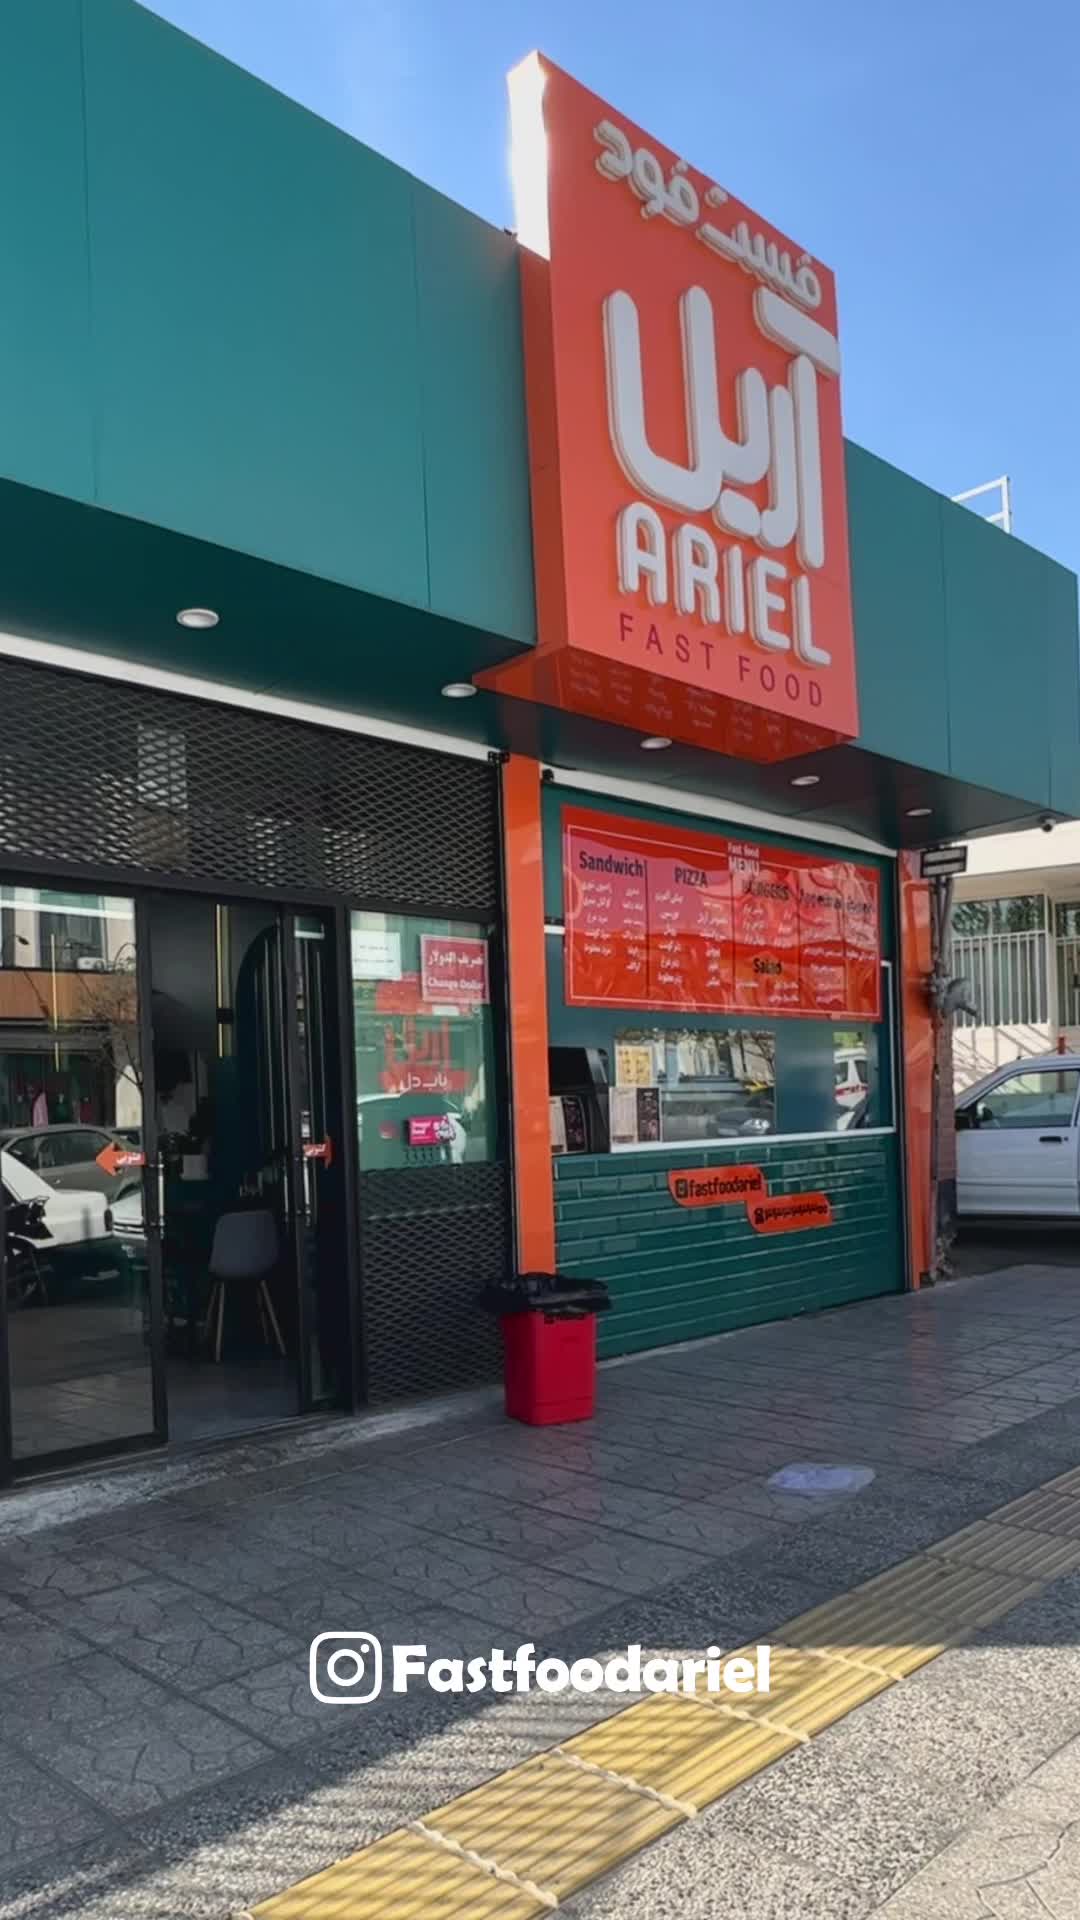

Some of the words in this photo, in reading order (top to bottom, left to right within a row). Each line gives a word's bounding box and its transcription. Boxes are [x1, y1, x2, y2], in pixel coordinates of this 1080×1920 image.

[593, 119, 700, 224] فود
[696, 185, 823, 310] فست
[602, 286, 841, 568] آریل
[616, 501, 832, 667] ARIEL
[618, 612, 715, 671] FAST
[737, 655, 824, 707] FOOD
[579, 851, 644, 878] Sandwich
[674, 866, 709, 888] PIZZA
